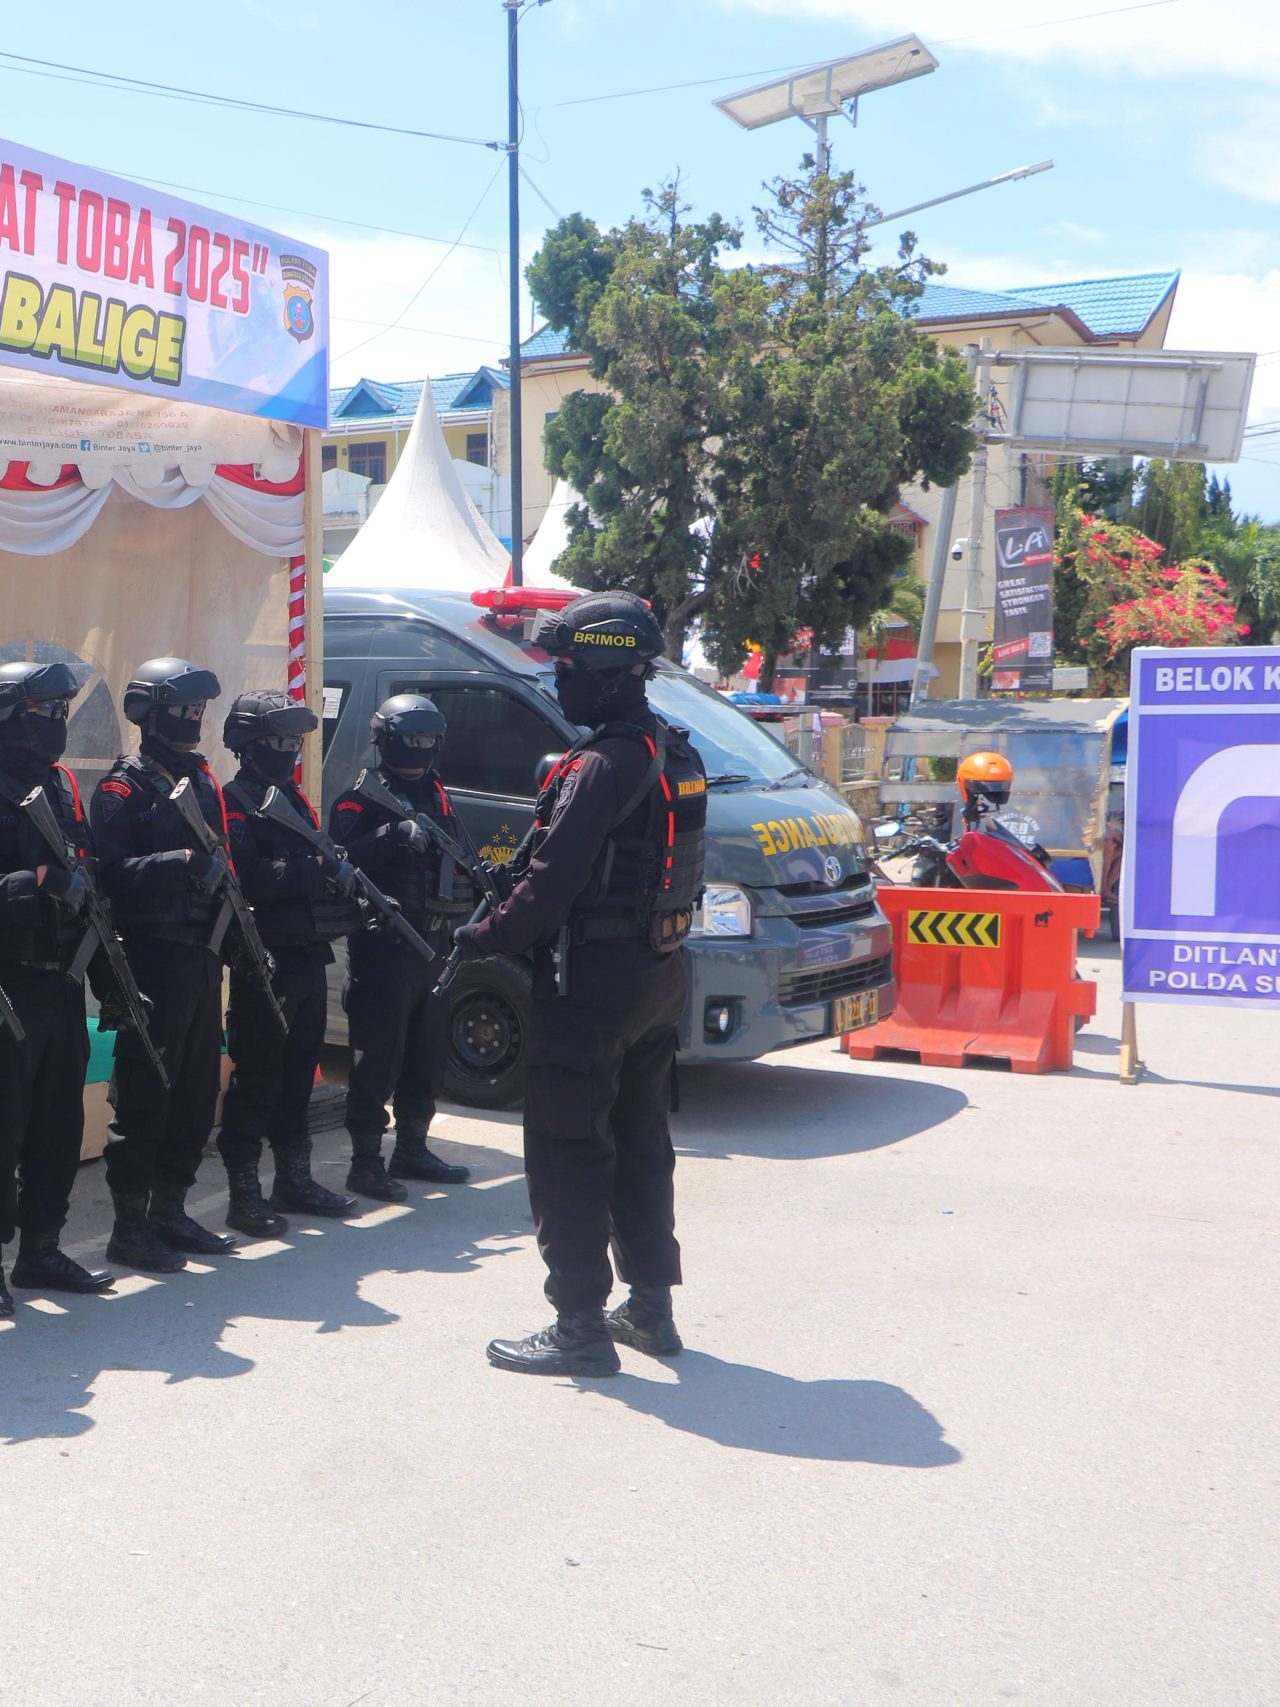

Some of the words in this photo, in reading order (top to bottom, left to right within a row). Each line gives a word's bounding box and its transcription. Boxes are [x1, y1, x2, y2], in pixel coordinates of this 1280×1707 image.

[54, 181, 154, 289] TOBA
[164, 216, 269, 313] 2025"
[118, 445, 136, 453] Jaya
[998, 578, 1026, 589] GREAT
[1000, 584, 1049, 599] SATISFACTION
[1001, 594, 1045, 608] STRONGER
[1003, 606, 1028, 617] TASTE
[574, 631, 636, 647] BRIMOB
[1155, 666, 1254, 692] BELOK
[1174, 944, 1280, 967] DITLAN
[1149, 970, 1247, 992] POLDA
